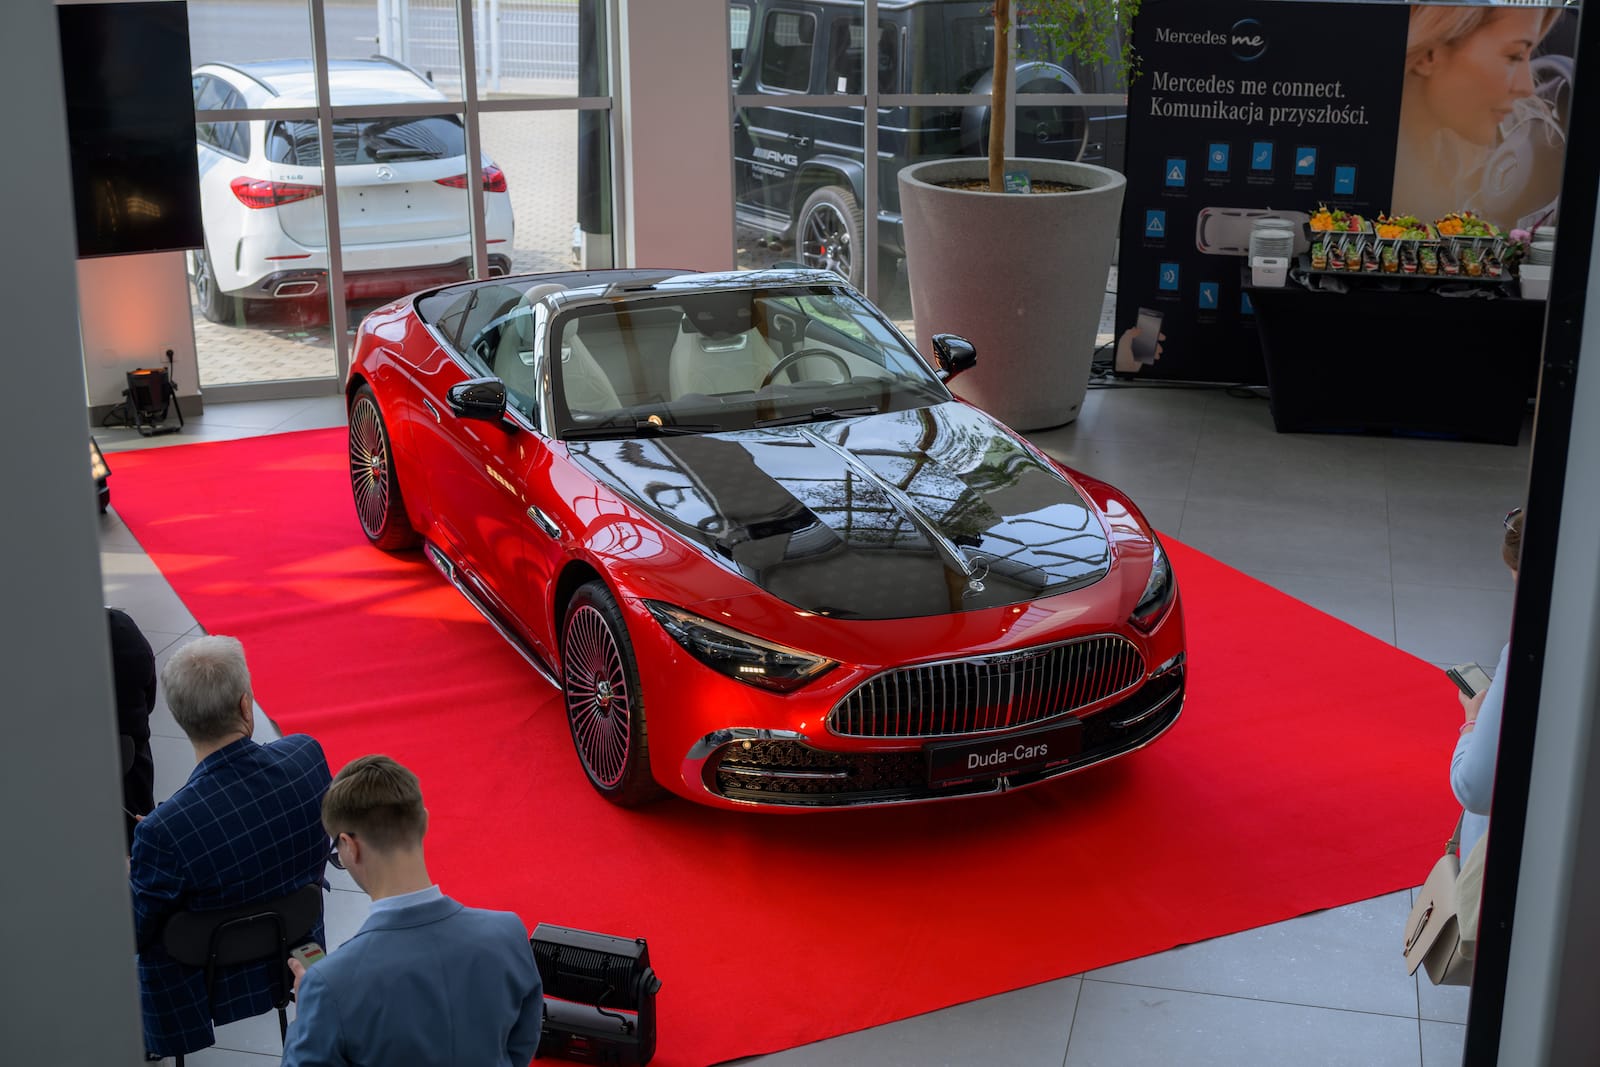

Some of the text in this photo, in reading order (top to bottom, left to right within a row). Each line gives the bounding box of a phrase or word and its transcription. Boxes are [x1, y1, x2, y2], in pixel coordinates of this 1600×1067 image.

[1155, 27, 1264, 46] Mercedes me
[1152, 71, 1345, 98] Mercedes me connect.
[1151, 97, 1369, 127] Komunikacja przyszłości.
[766, 150, 798, 166] AMG
[967, 743, 1048, 769] Duda-Cars
